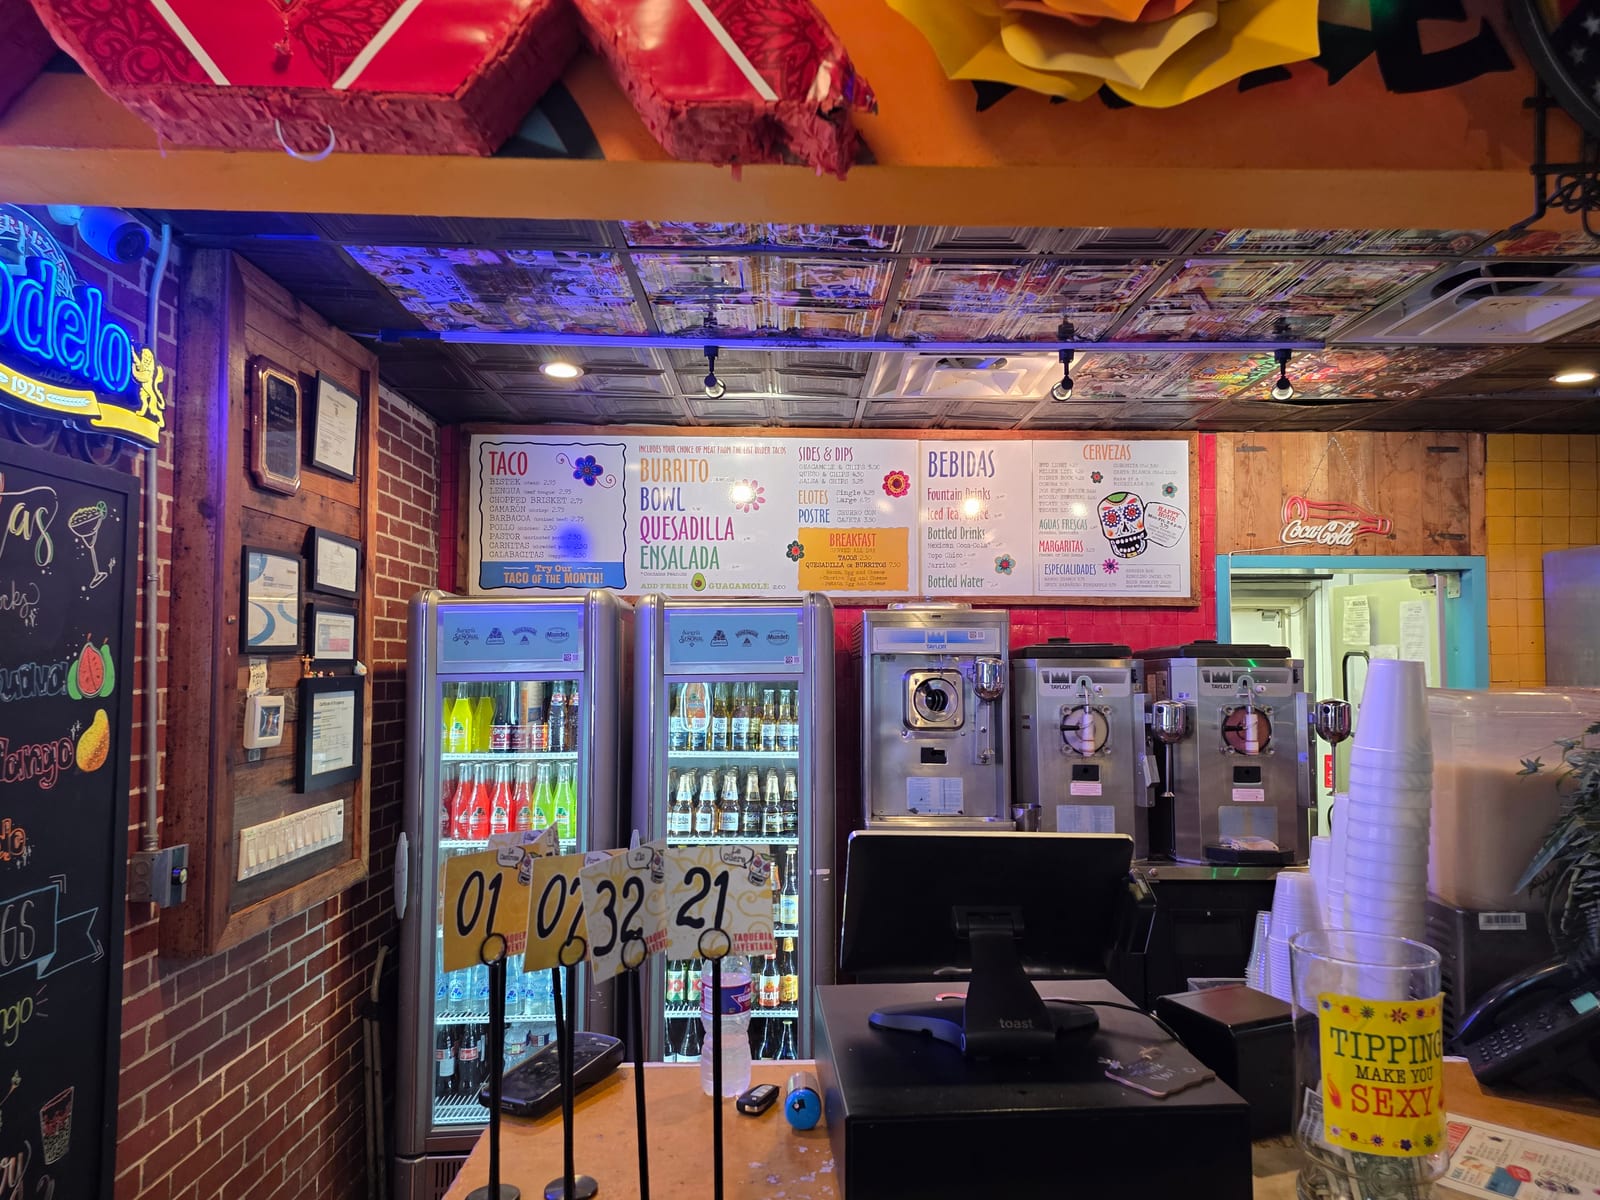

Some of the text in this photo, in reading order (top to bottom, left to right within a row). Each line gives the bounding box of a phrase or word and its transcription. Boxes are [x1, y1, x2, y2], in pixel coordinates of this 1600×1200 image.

[0, 258, 132, 393] delo
[11, 375, 46, 403] 1925
[639, 445, 661, 453] INCLUDES
[677, 446, 694, 454] CHOICE
[696, 446, 700, 454] OF
[704, 446, 715, 454] MEAT
[799, 446, 853, 462] SIDES & DIPS
[1083, 444, 1132, 461] CERVEZAS
[489, 451, 528, 475] TACO
[640, 458, 709, 483] BURRITO
[928, 450, 995, 478] BEBIDAS
[640, 487, 685, 511] BOWL
[799, 490, 828, 505] ELOTES
[927, 487, 962, 500] Fountain
[965, 487, 991, 500] Drinks
[489, 504, 526, 512] CAMARÓN
[799, 508, 830, 523] POSTRE
[928, 507, 943, 519] Iced
[640, 516, 735, 544] QUESADILLA
[1039, 519, 1088, 530] AGUAS FRESCAS
[829, 533, 877, 547] BREAKFAST
[928, 526, 985, 540] Bottled Drinks
[1039, 540, 1084, 553] MARGARITAS
[640, 545, 720, 570] ENSALADA
[535, 564, 552, 574] Try
[1044, 563, 1096, 576] ESPECIALIDADES
[504, 572, 604, 584] TACO OF THE MONTH!
[928, 574, 984, 588] Bottled Water
[0, 737, 74, 790] ango
[457, 870, 503, 936] 01
[675, 867, 729, 929] 21
[593, 876, 644, 956] 32
[733, 932, 773, 943] TAQUERIA
[741, 942, 774, 951] VENTANA
[999, 1017, 1033, 1030] toast
[1330, 1027, 1442, 1064] TIPPING
[1355, 1065, 1433, 1084] MAKE YOU
[1351, 1084, 1433, 1118] SEXY
